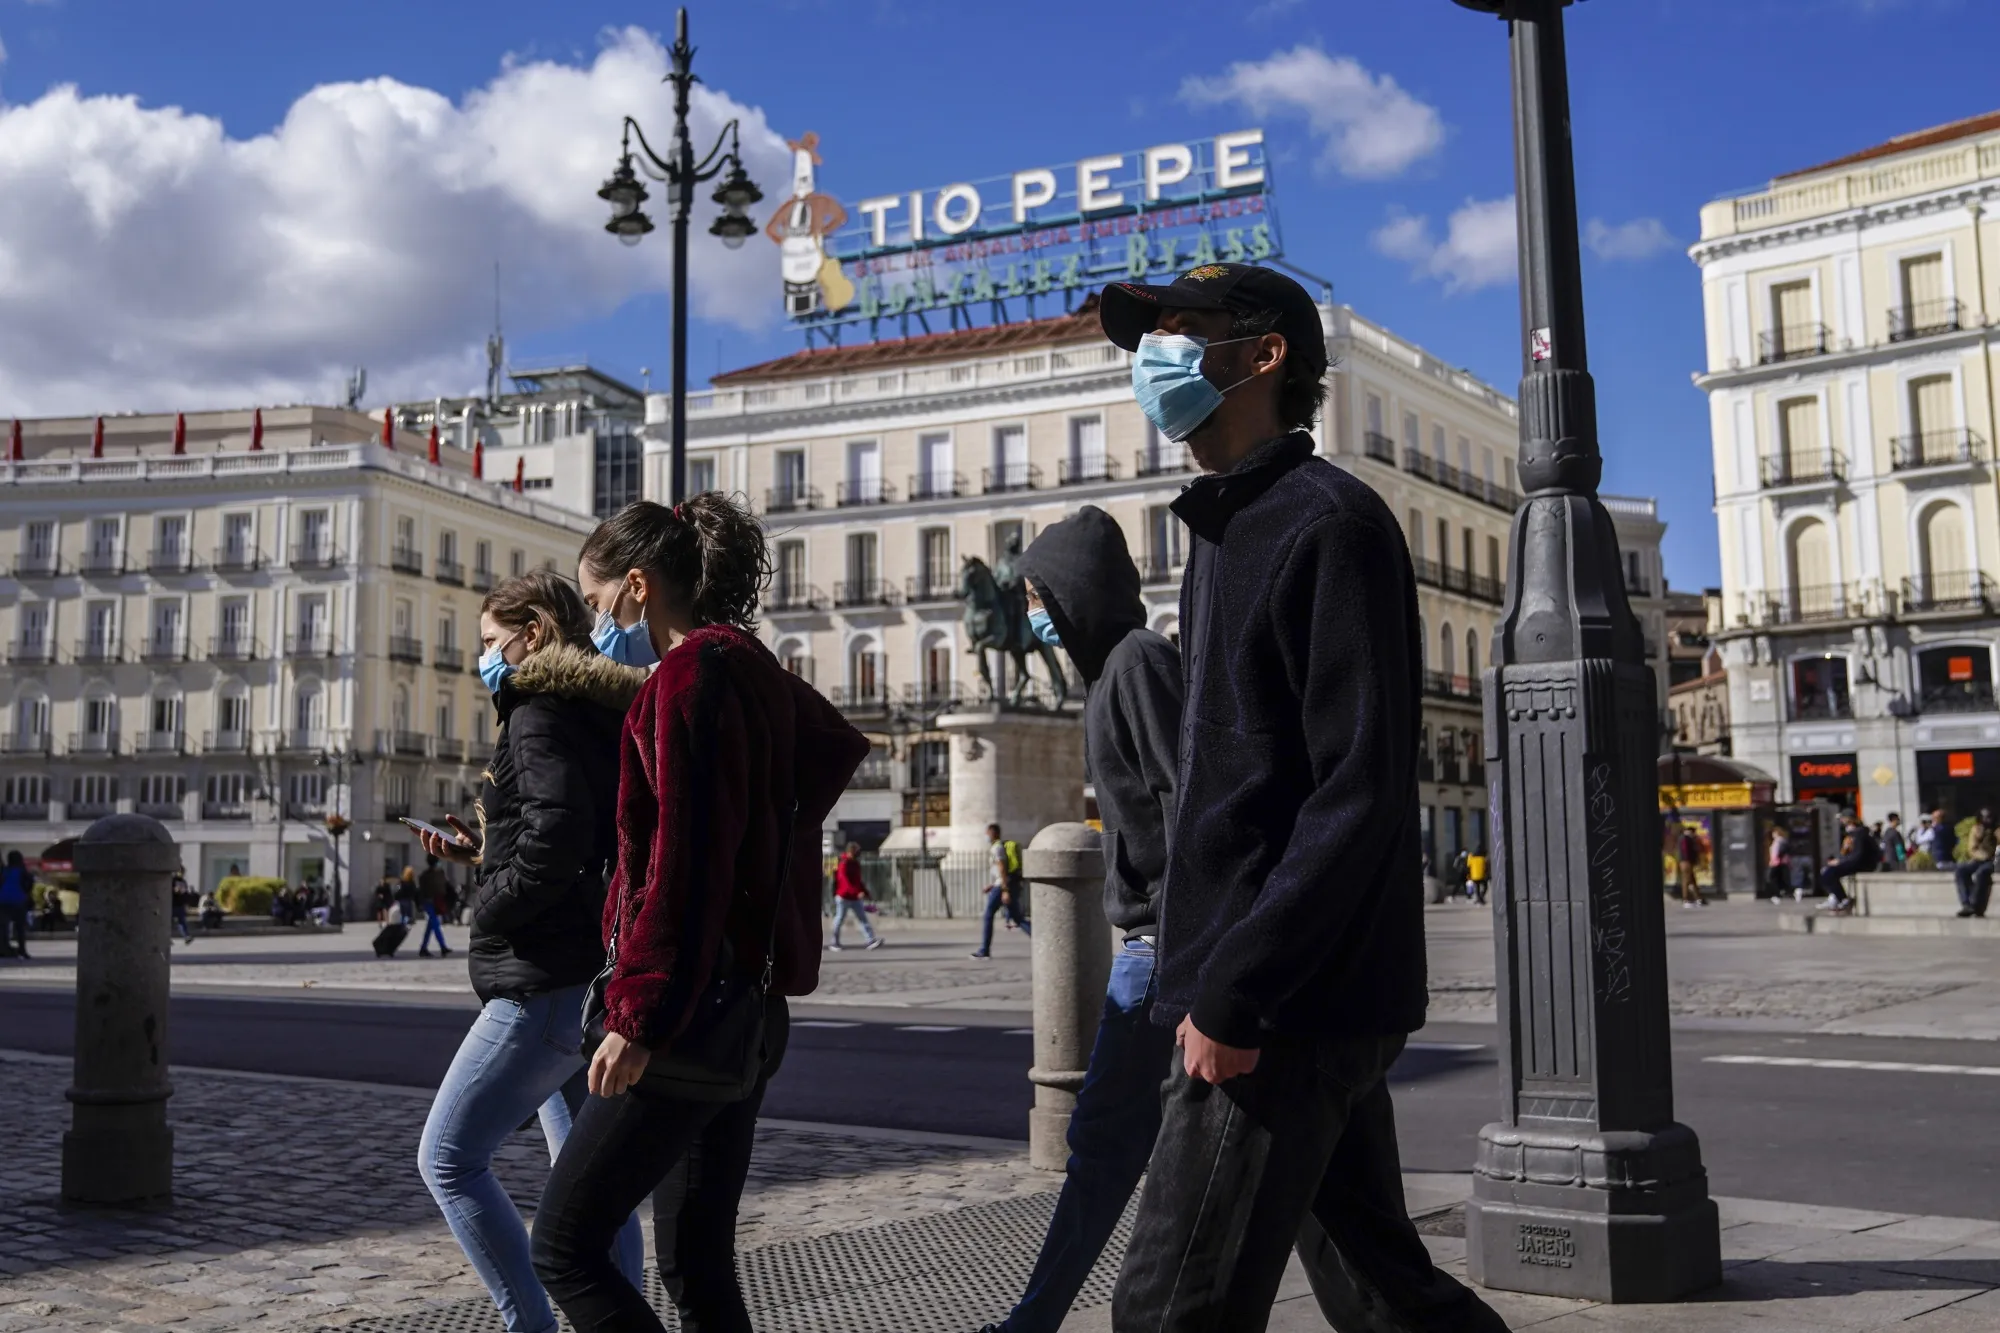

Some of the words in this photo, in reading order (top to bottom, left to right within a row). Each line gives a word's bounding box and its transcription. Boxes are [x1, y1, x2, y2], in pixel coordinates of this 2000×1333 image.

[858, 183, 981, 247] TIO
[1012, 129, 1265, 224] PEPE
[855, 253, 900, 278] SOL
[906, 247, 934, 269] DE
[1079, 194, 1265, 241] EMBOTELLADO
[1126, 222, 1271, 279] BYASS
[1798, 762, 1852, 778] Orange
[1515, 1235, 1576, 1257] JAREÑO
[1520, 1255, 1572, 1268] MADRID
